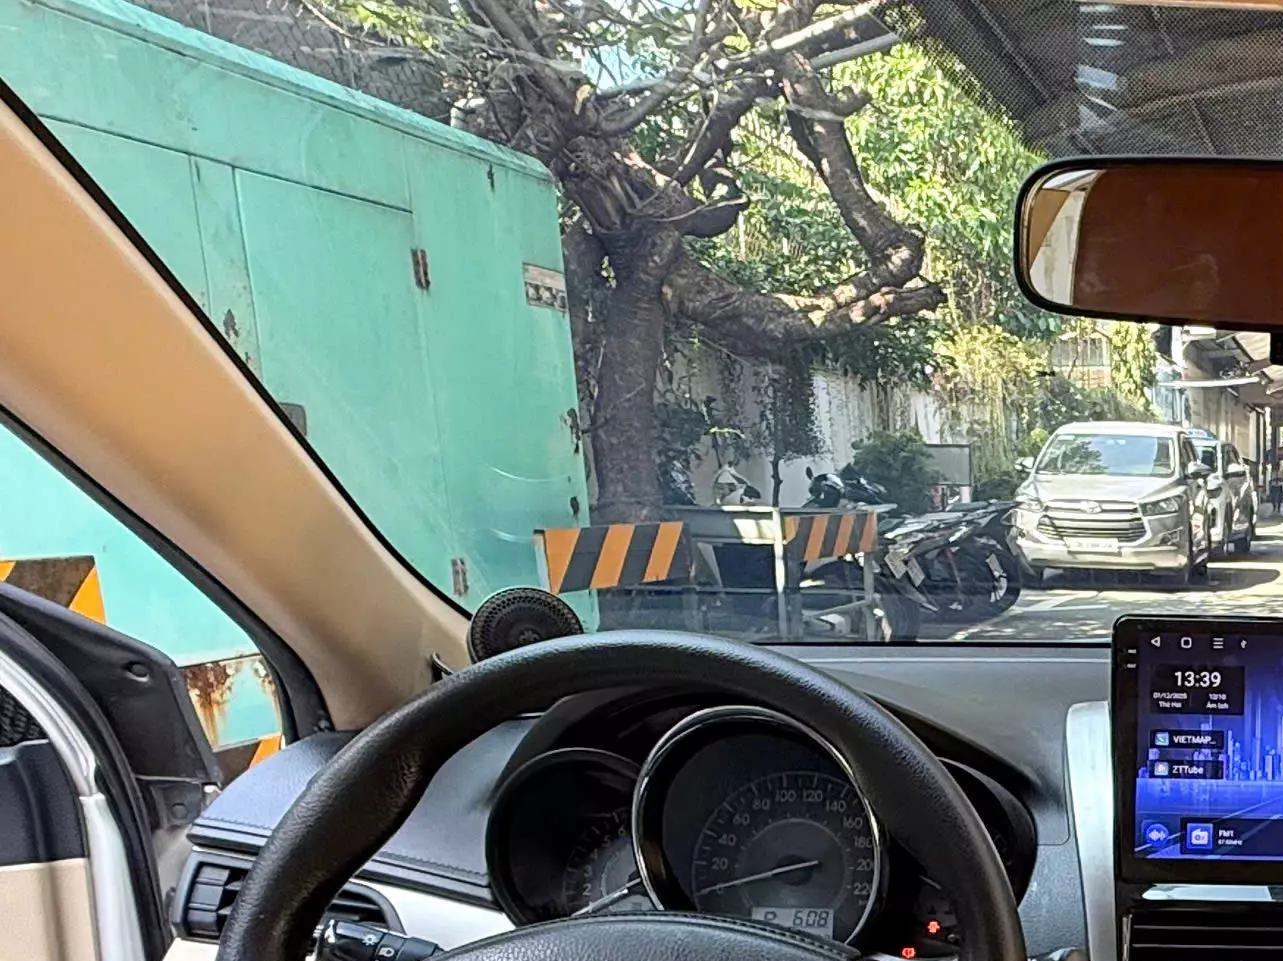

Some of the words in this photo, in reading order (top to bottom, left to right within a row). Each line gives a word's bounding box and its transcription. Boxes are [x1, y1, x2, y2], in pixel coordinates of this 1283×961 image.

[1174, 671, 1222, 688] 13:39
[1172, 765, 1204, 775] ZTTube
[775, 789, 797, 801] 100
[802, 789, 824, 801] 120
[752, 799, 770, 811] 80
[825, 800, 847, 812] 140
[732, 814, 750, 826] 60
[843, 817, 864, 829] 160
[718, 833, 737, 847] 40
[711, 857, 728, 870] 20
[583, 883, 592, 896] 2
